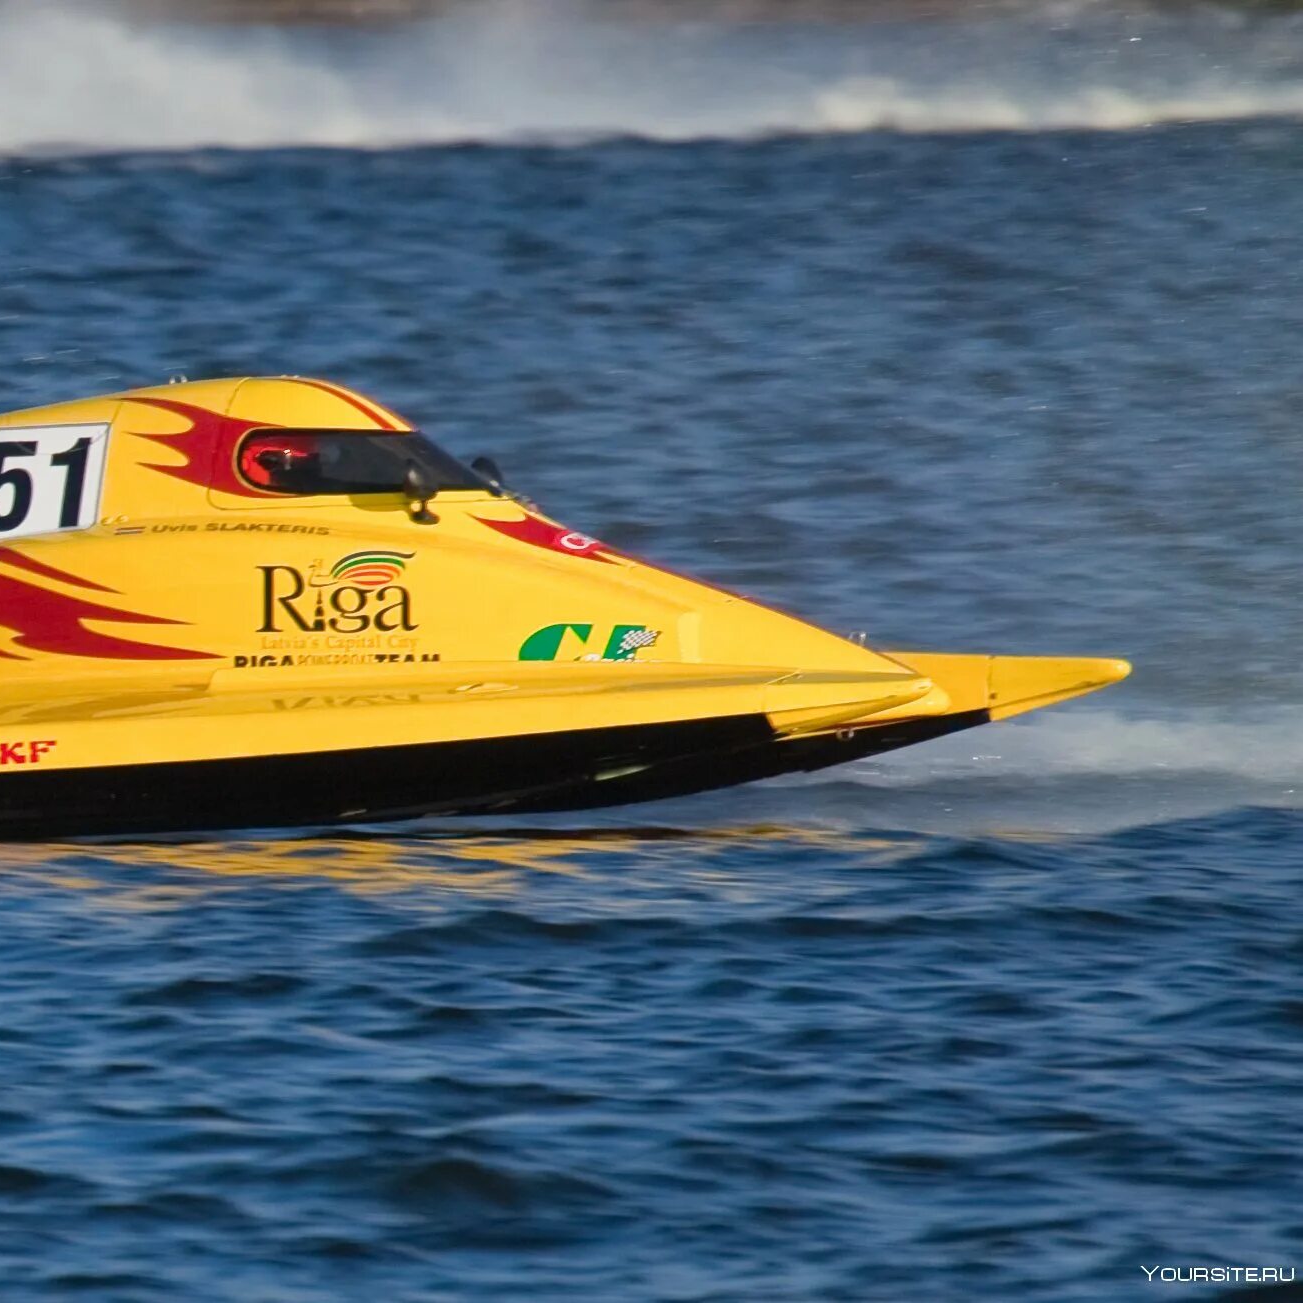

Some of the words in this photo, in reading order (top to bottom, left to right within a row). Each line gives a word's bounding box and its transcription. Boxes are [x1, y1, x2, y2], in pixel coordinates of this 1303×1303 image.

[151, 524, 197, 534] Uvis
[205, 522, 330, 536] SLAKTERIS
[255, 564, 420, 634] Riga
[325, 634, 381, 652] Capital
